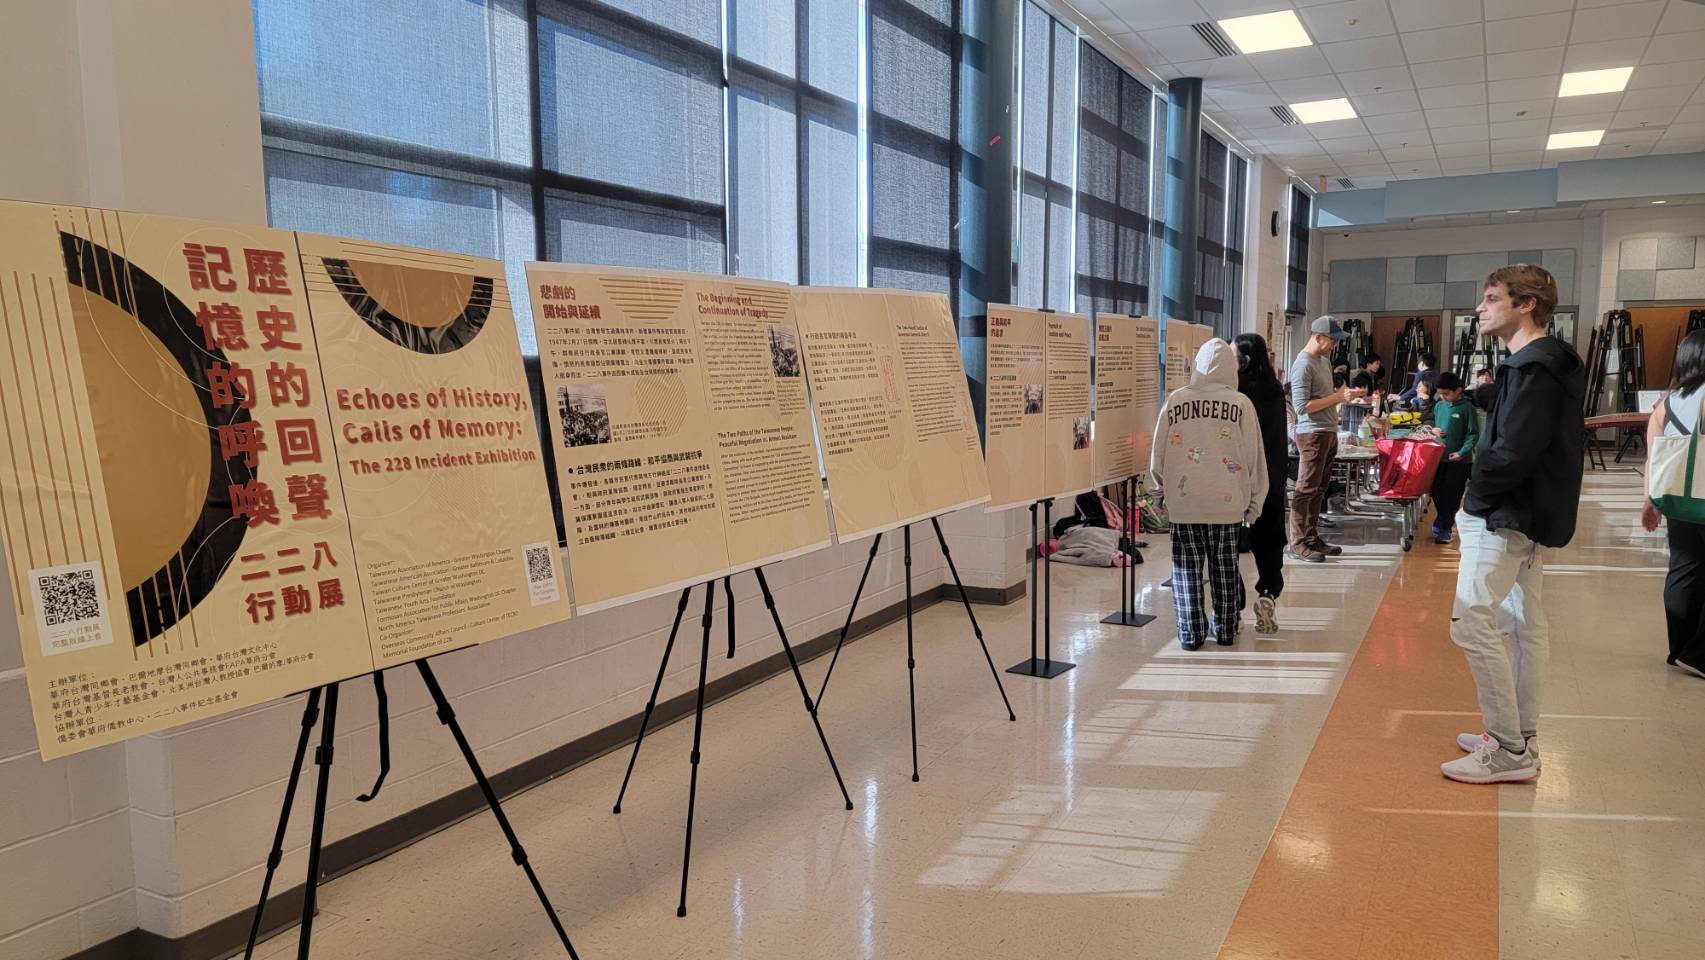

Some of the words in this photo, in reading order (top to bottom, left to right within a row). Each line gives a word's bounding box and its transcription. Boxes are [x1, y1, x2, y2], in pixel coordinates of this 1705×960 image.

[540, 284, 576, 300] 悲劇的
[696, 292, 708, 301] The
[710, 293, 740, 305] Beginning
[742, 296, 752, 305] and
[543, 304, 601, 320] 開始與延續
[699, 305, 739, 316] Continuation
[740, 307, 746, 316] of
[747, 308, 768, 319] Tragedy
[182, 242, 281, 529] 記憶的呼喚
[242, 246, 333, 520] 歷史的回聲
[336, 388, 420, 411] Echoes
[426, 388, 449, 408] of
[452, 387, 528, 412] History,
[342, 420, 404, 444] Calls
[409, 418, 432, 440] of
[437, 419, 522, 440] Memory:
[349, 459, 382, 475] The
[384, 456, 412, 472] 228
[415, 453, 473, 470] Incident
[475, 448, 536, 465] Exhibition
[240, 540, 338, 582] 二二八
[368, 570, 396, 578] Taiwanese
[398, 564, 424, 572] Association
[472, 551, 495, 560] Washington
[453, 571, 478, 579] Washington
[245, 578, 345, 625] 行動展
[374, 596, 401, 605] Taiwanese
[402, 589, 432, 598] Presbyterian
[456, 579, 481, 588] Washington
[376, 605, 402, 613] Taiwanese
[377, 614, 402, 623] Formosan
[404, 608, 430, 616] Association
[469, 593, 494, 602] Washington
[396, 620, 415, 628] America
[416, 614, 441, 622] Taiwanese
[382, 640, 405, 649] Overseas
[406, 633, 434, 643] Community
[451, 624, 466, 632] Council
[383, 649, 408, 658] Memorial
[409, 641, 436, 651] Foundation
